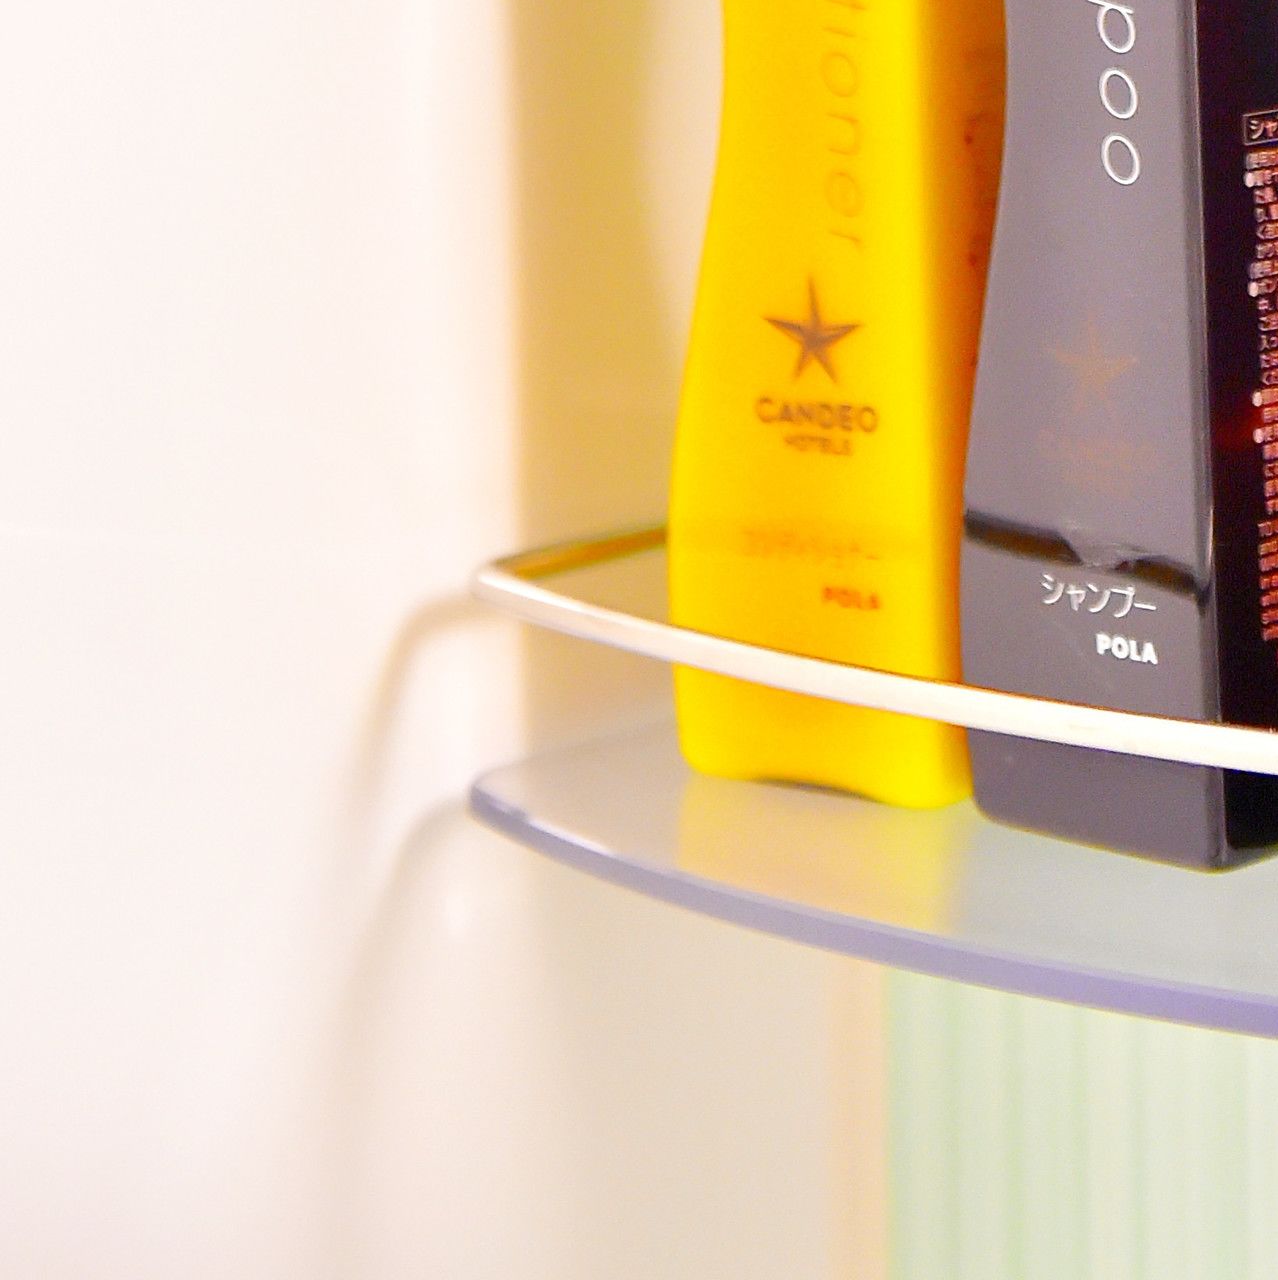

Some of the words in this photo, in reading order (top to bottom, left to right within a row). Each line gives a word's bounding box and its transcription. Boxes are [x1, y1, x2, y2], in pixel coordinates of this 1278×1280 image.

[755, 397, 879, 433] CANDEO
[1041, 573, 1156, 618] シャンプー
[1096, 633, 1158, 665] POLA
